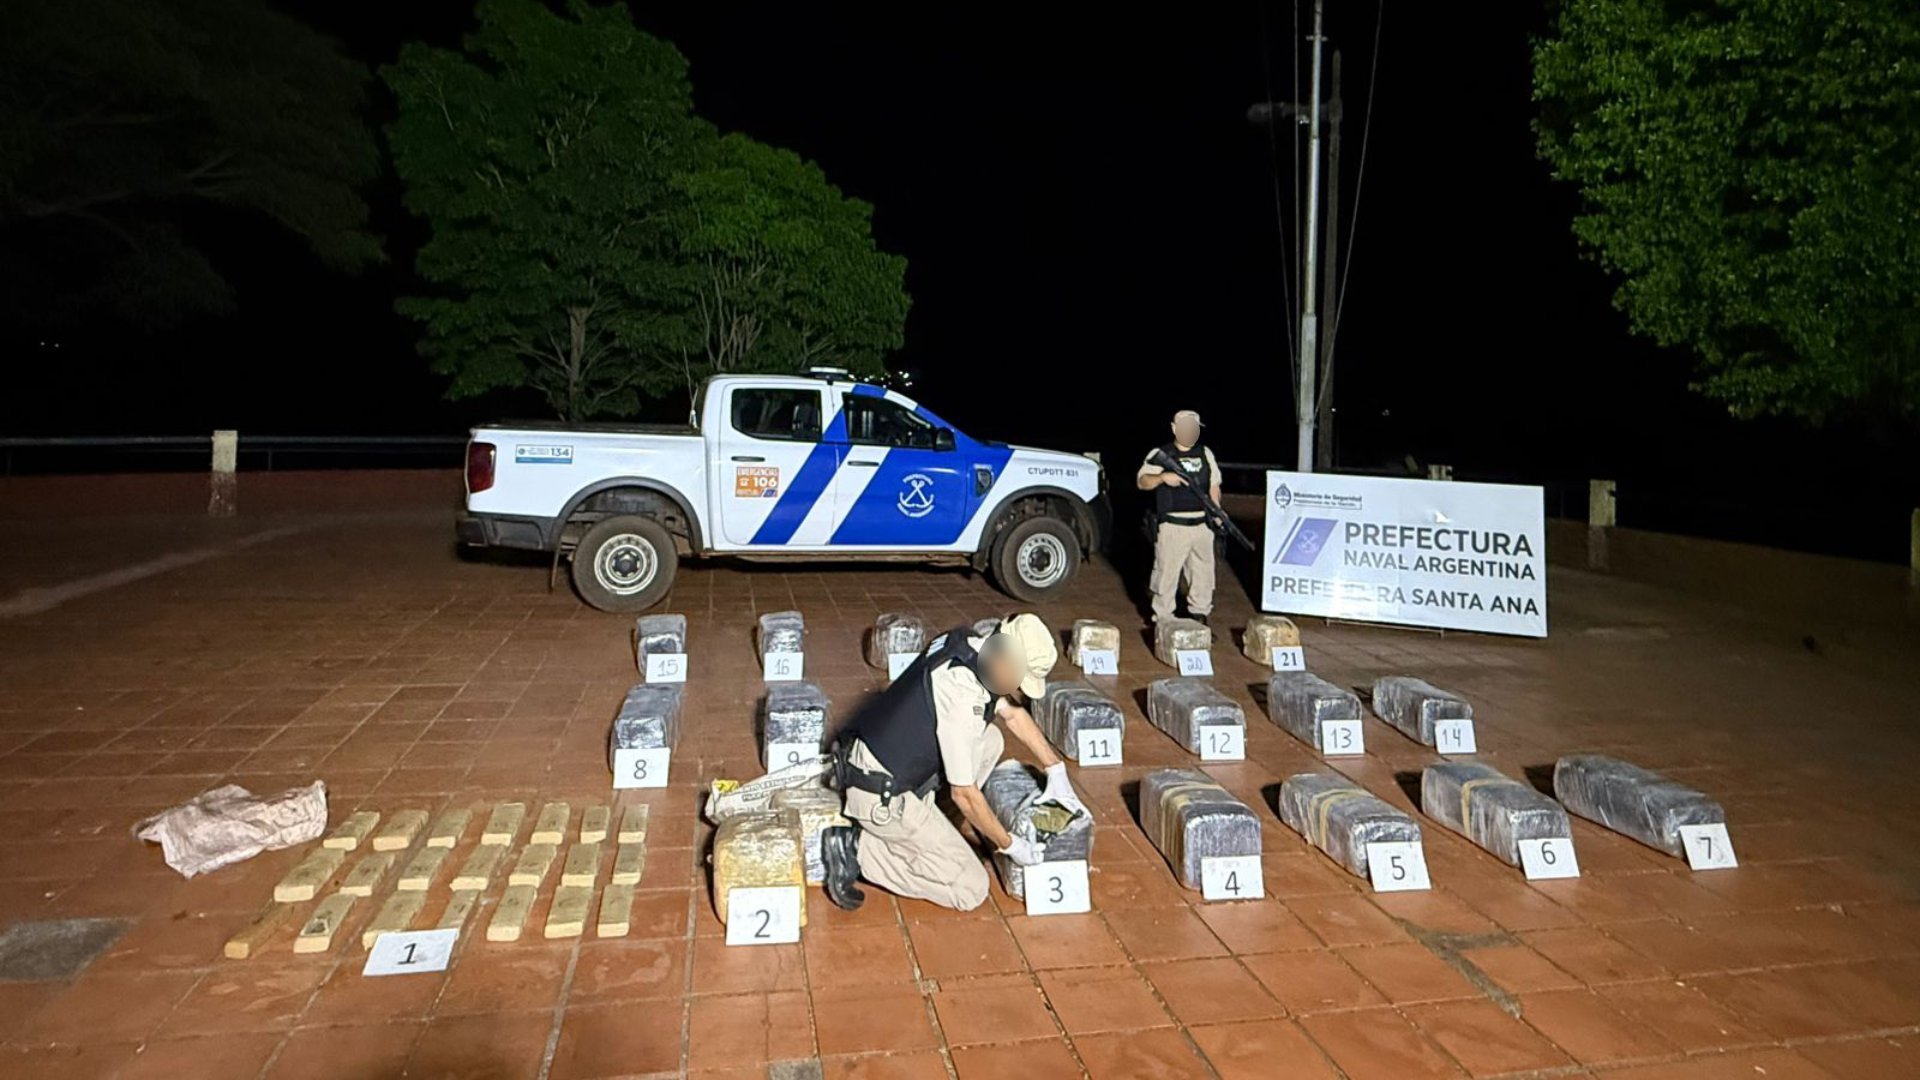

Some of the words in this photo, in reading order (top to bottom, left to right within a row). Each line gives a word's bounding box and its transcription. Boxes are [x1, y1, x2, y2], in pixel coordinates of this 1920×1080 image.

[551, 447, 569, 456] 134
[753, 477, 777, 488] 106
[1293, 491, 1322, 499] Ministerio
[1332, 494, 1363, 502] Seguridad
[1344, 522, 1534, 557] PREFECTURA
[1344, 550, 1409, 571] NAVAL
[1414, 555, 1536, 581] ARGENTINA
[1412, 588, 1483, 612] SANTA
[1490, 596, 1539, 616] ANA
[657, 659, 679, 677] 15
[774, 658, 790, 675] 16
[1091, 656, 1105, 670] 19
[1187, 657, 1203, 671] 20
[1282, 652, 1298, 667] 21
[1088, 739, 1111, 758] 11
[1209, 732, 1232, 754] 12
[1330, 727, 1352, 749] 13
[1442, 728, 1461, 748] 14
[633, 759, 647, 780] 8
[1541, 841, 1556, 866] 6
[1700, 836, 1713, 860] 7
[1391, 856, 1406, 880] 5
[1048, 876, 1064, 903] 3
[1225, 870, 1241, 895] 4
[754, 909, 771, 939] 2
[397, 942, 418, 965] 1
